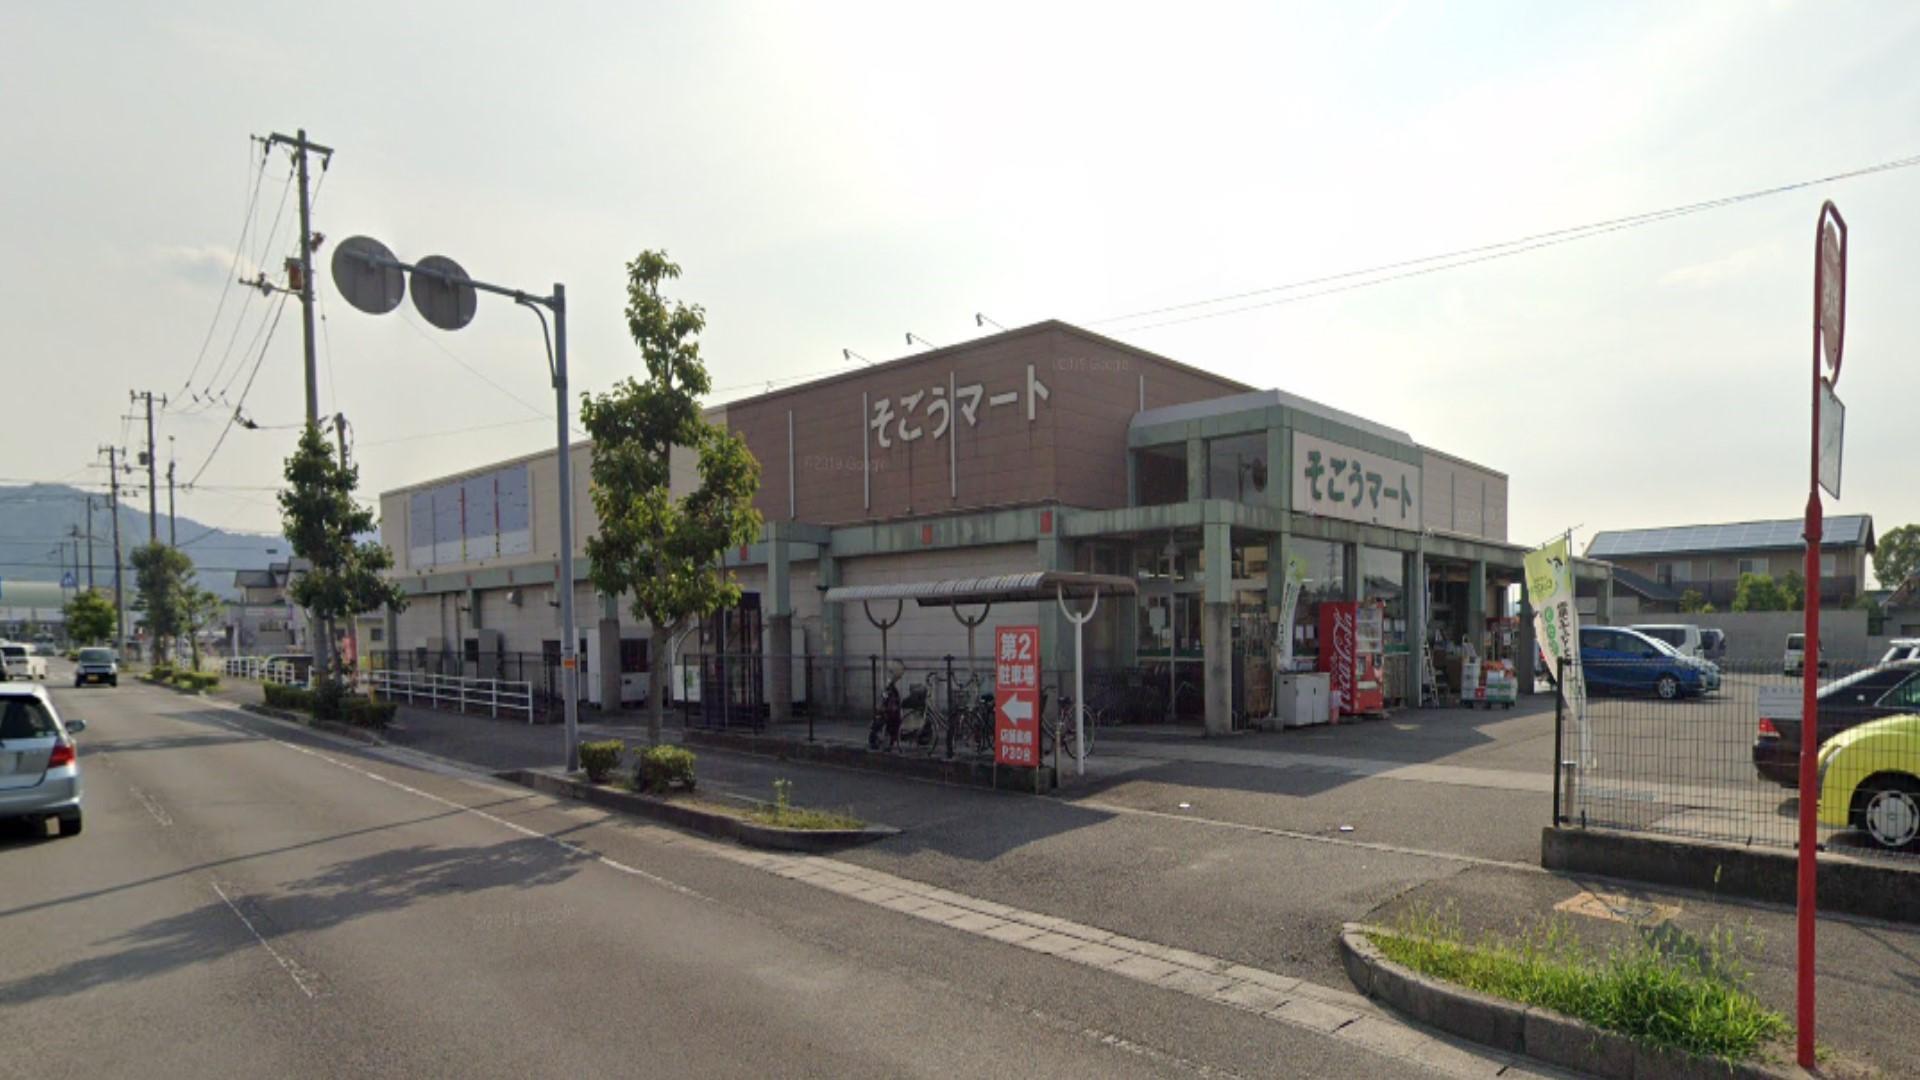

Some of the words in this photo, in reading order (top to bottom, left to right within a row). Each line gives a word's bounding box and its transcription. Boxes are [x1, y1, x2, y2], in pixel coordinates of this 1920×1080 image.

[1000, 632, 1031, 661] 第2
[998, 664, 1034, 686] 駐車場
